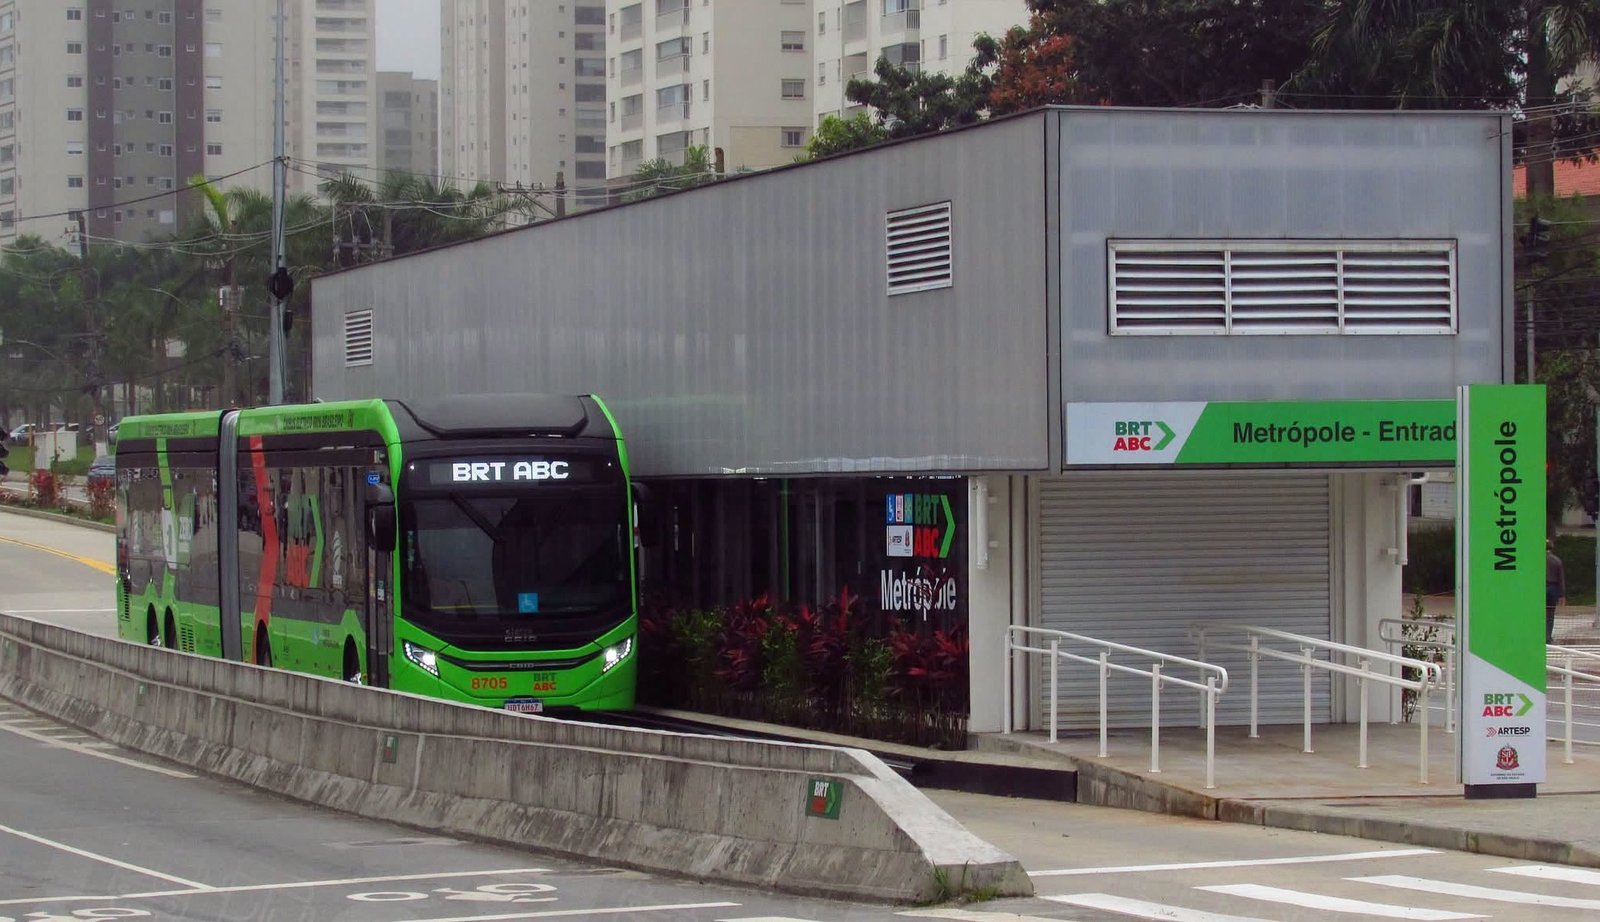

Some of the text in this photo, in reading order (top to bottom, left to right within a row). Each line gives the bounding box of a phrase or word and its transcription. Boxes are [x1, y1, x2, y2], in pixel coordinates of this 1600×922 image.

[1115, 422, 1152, 436] BRT
[1233, 421, 1356, 448] Metrópole
[1379, 420, 1457, 442] Entrad
[1114, 437, 1151, 451] ABC
[452, 461, 569, 481] BRT ABC
[1494, 421, 1522, 570] Metrópole
[914, 493, 940, 525] BRT
[914, 527, 940, 558] ABC
[471, 677, 507, 690] 8705
[533, 681, 556, 691] ABC
[1484, 693, 1514, 705] BRT
[1482, 705, 1513, 717] ABC
[1497, 726, 1531, 735] ARTESP
[813, 781, 830, 798] BRT
